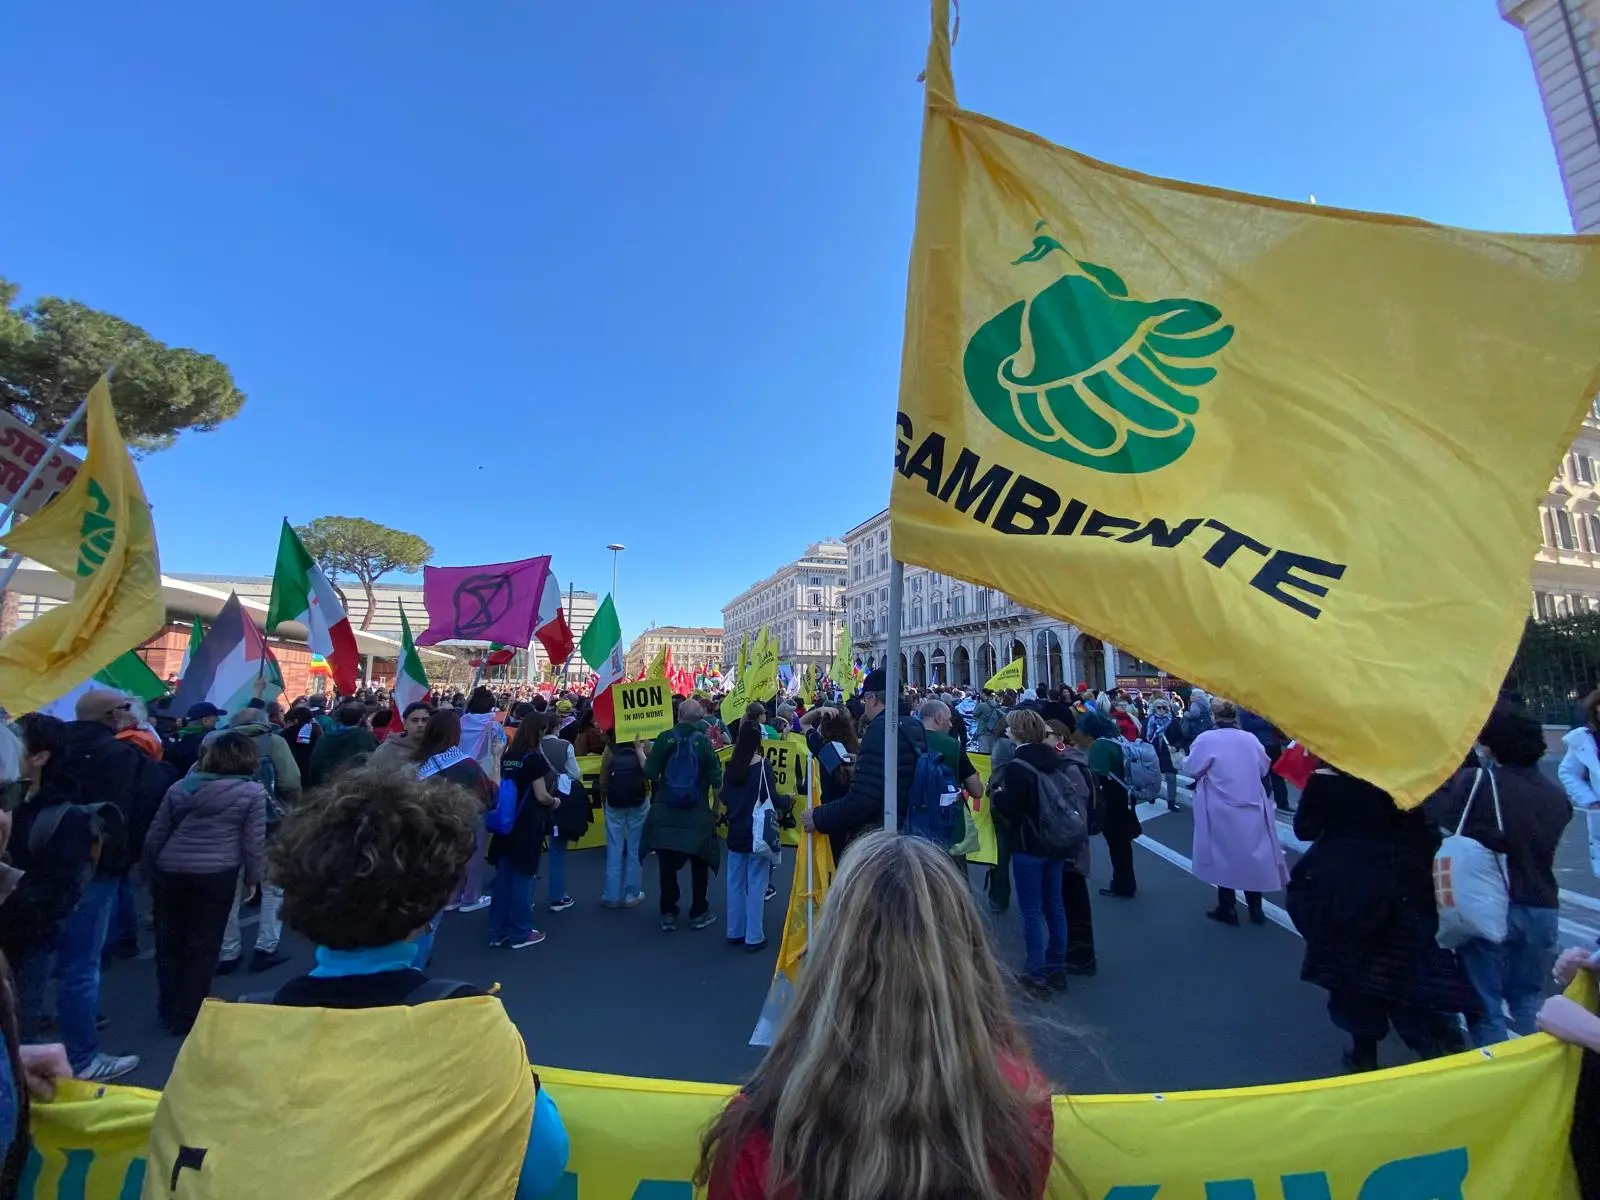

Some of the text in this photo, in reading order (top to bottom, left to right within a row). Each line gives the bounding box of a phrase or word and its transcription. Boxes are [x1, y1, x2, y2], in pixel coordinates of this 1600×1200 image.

[622, 686, 662, 709] NON
[633, 712, 645, 720] MIO
[646, 710, 664, 718] NOME
